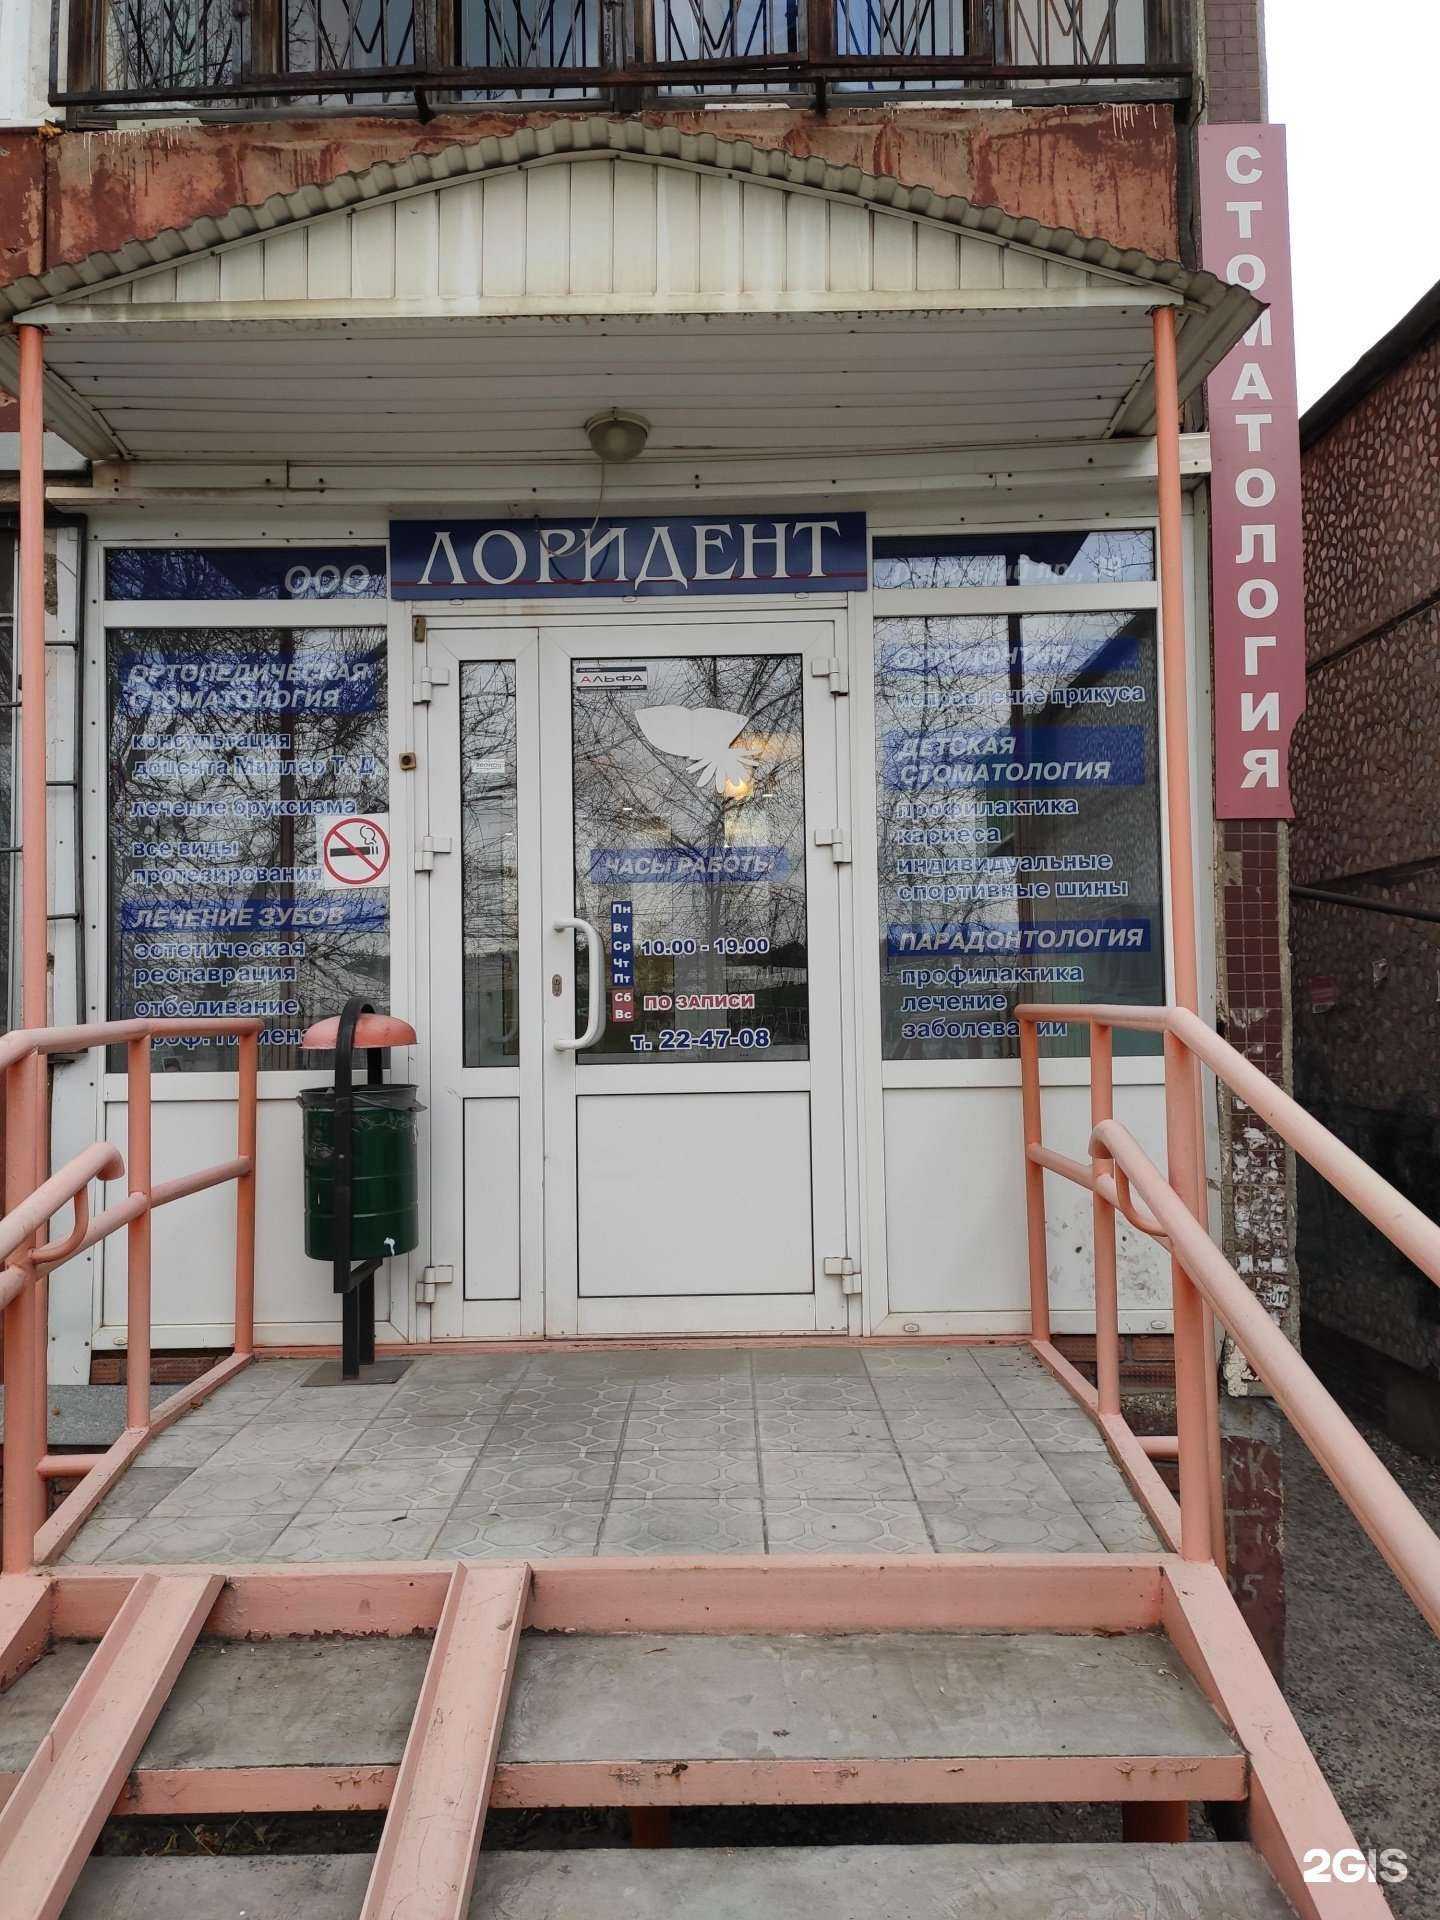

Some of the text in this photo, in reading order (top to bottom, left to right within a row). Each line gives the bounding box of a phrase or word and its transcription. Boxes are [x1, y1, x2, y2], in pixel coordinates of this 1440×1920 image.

[1225, 145, 1281, 788] СТОМАТОЛОГИЯ
[416, 520, 842, 592] ЛОРИДЕНТ
[893, 646, 1066, 668] ОРДОНТИЯ
[128, 661, 370, 684] ОРТОПЕДИЧЕСКАЯ
[581, 675, 643, 683] АЛЬФА
[128, 688, 340, 710] СТОМАТОЛОГИЯ
[896, 686, 1146, 711] исправление прикуса
[131, 733, 292, 752] консультация
[898, 737, 1016, 757] ДЕТСКАЯ
[133, 758, 229, 778] доцента
[901, 762, 1111, 782] СТОМАТОЛОГИЯ
[131, 796, 358, 820] лечение бруксизма
[897, 799, 1079, 819] профилактика
[899, 828, 1000, 846] кариеса
[132, 841, 239, 860] все виды
[607, 856, 776, 875] ЧАСЫ РАБОТЫ
[897, 855, 1114, 875] индивидуальные
[132, 865, 324, 887] протезирования
[898, 880, 1129, 903] спортивные шины
[130, 907, 345, 928] ЛЕЧЕНИЕ ЗУБОВ
[613, 905, 631, 914] Пн
[613, 923, 628, 933] Вт
[613, 941, 631, 953] Ср
[641, 939, 696, 956] 10.00
[714, 938, 769, 954] 19.00
[899, 929, 1144, 952] ПАРАДОНТОЛОГИЯ
[134, 942, 306, 960] эстетическая
[613, 959, 629, 968] Чт
[134, 966, 296, 988] реставрация
[614, 974, 630, 984] Пт
[901, 966, 1084, 988] профилактика
[615, 992, 632, 1002] Сб
[644, 994, 755, 1011] ПО ЗАПИСИ
[901, 995, 1008, 1012] лечение
[134, 999, 300, 1017] отбеливание
[615, 1010, 632, 1019] Вс
[902, 1018, 1068, 1038] заболеваии
[150, 1028, 305, 1050] роф. ииен
[631, 1028, 770, 1050] т. 22-47-08
